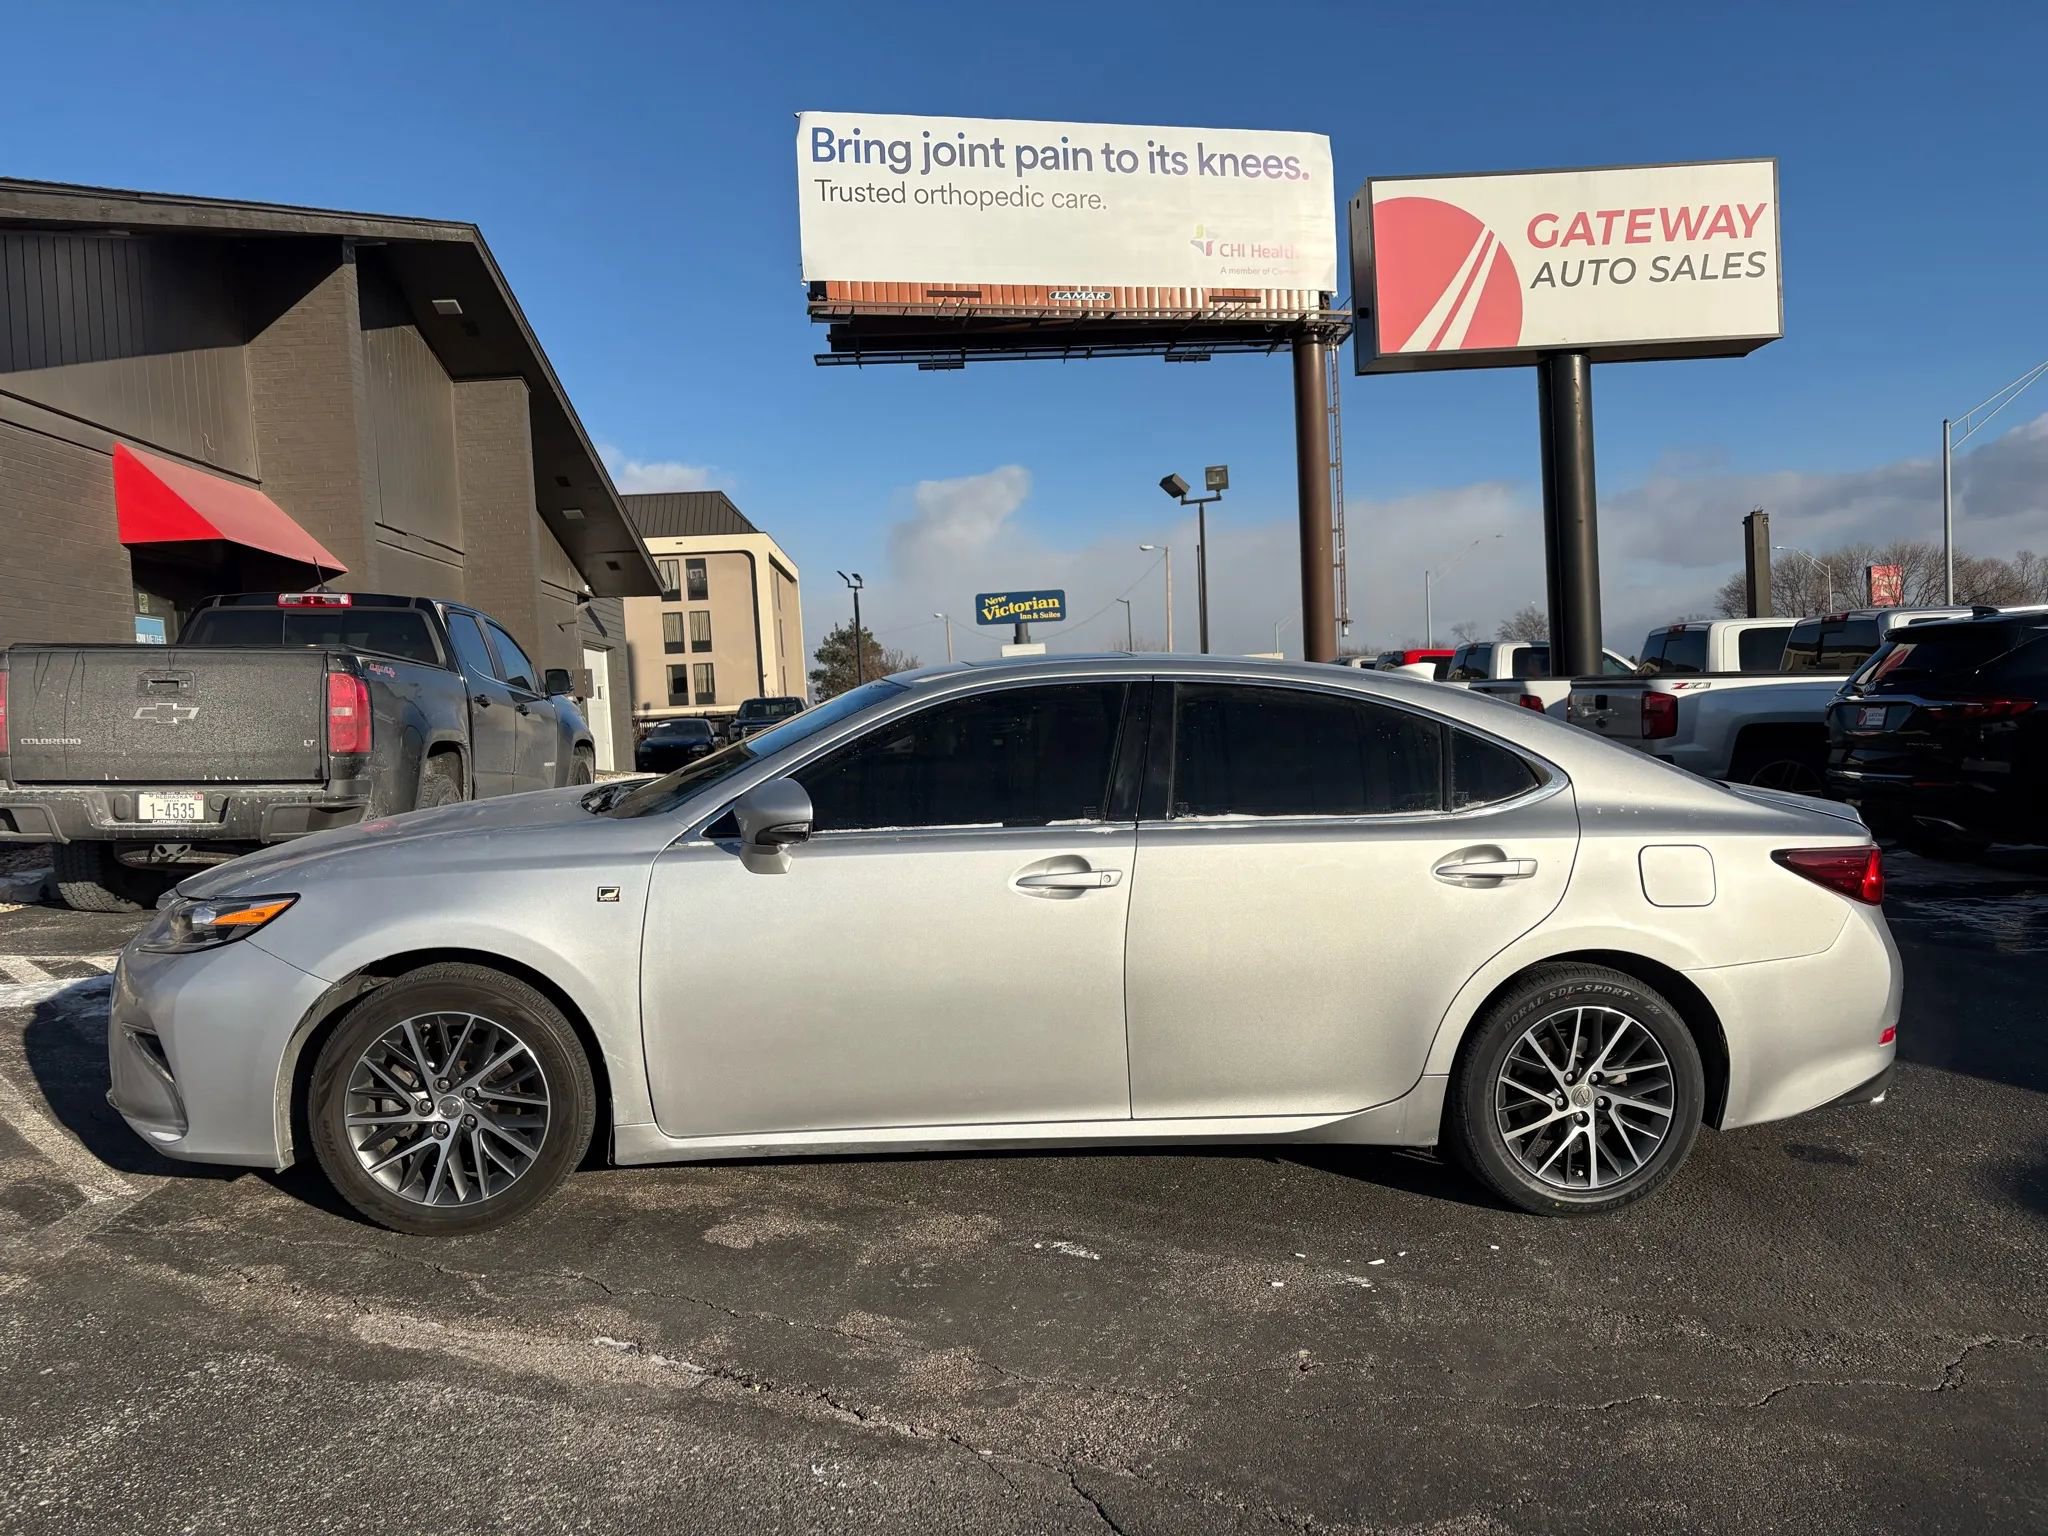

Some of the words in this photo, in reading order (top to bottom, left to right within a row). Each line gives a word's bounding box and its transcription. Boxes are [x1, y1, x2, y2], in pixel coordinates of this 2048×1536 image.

[810, 127, 913, 176] Bring
[920, 131, 1006, 176] joint
[1015, 136, 1094, 177] pain
[1101, 142, 1140, 176] to
[1148, 138, 1189, 177] its
[1197, 142, 1311, 182] knees.
[814, 179, 906, 205] Trusted
[914, 182, 1045, 212] orthopedic
[1051, 187, 1108, 211] care.
[1526, 203, 1768, 249] GATEWAY
[1219, 243, 1246, 258] CHI
[1220, 266, 1227, 275] A
[1229, 266, 1260, 275] member
[1262, 267, 1270, 276] of
[1530, 257, 1637, 289] AUTO
[1649, 251, 1768, 283] SALES
[1054, 291, 1106, 300] LAMAR
[981, 597, 1060, 621] Victorian
[1039, 611, 1061, 620] Suites
[303, 739, 316, 747] LT
[150, 802, 195, 819] 1-4535
[1505, 997, 1545, 1032] DORAL
